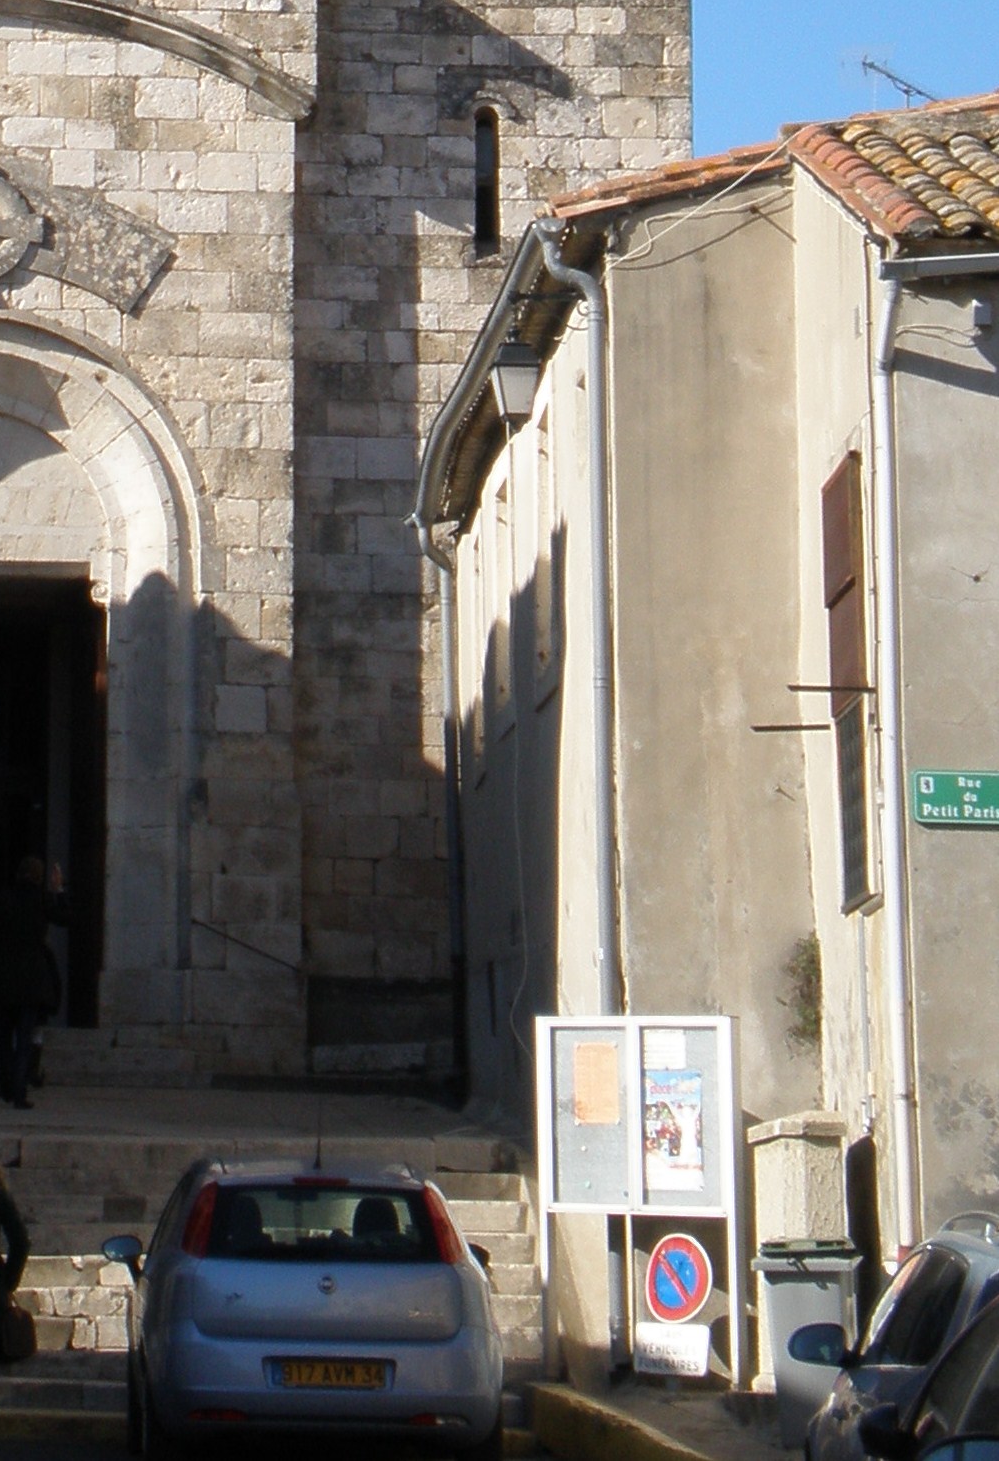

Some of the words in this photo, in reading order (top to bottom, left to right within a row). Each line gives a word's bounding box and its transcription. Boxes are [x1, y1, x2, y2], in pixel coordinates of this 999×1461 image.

[958, 776, 982, 788] Rue
[963, 792, 977, 802] du
[922, 803, 959, 817] Petit
